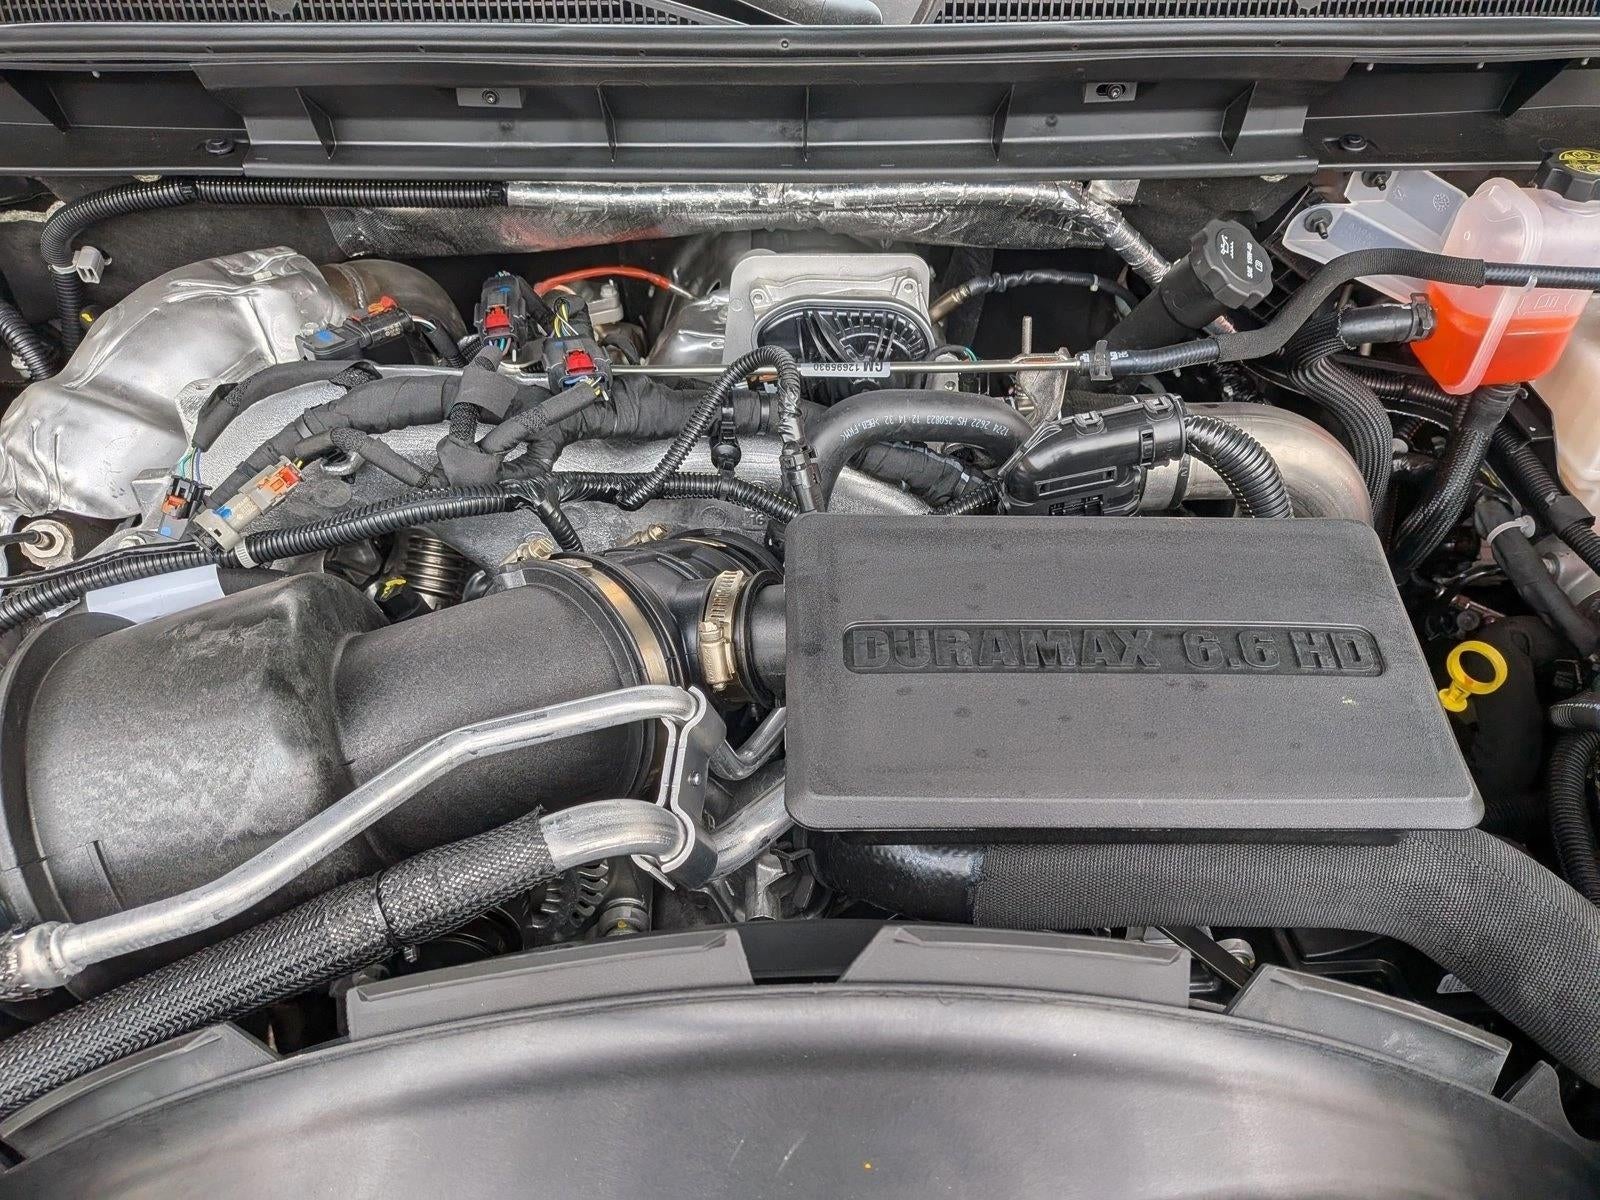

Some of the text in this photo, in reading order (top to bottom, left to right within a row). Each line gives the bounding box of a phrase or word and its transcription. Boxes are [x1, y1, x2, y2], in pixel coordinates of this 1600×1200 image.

[852, 629, 1376, 671] DURAMAX 6.6 HD
